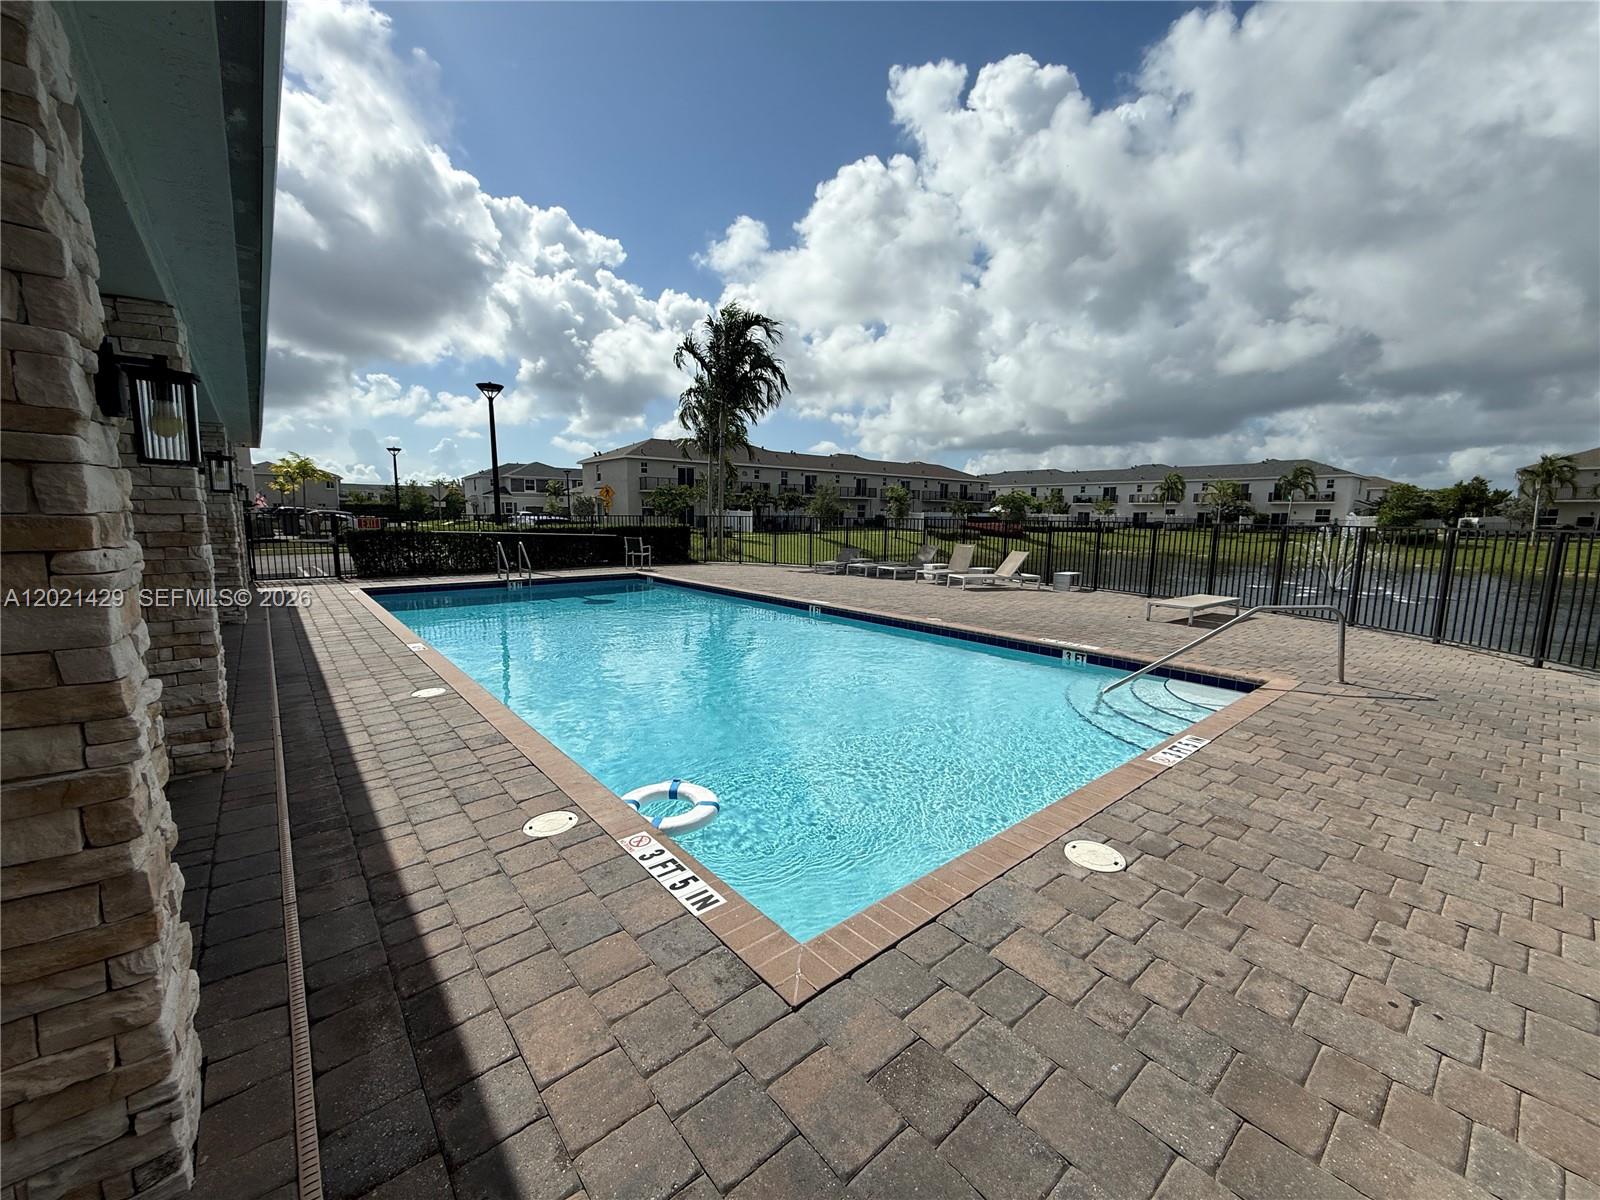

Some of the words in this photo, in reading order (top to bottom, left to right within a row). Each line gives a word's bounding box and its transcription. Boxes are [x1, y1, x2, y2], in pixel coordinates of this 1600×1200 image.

[361, 518, 377, 529] EXIT
[638, 848, 666, 861] 3
[648, 857, 687, 878] FT
[669, 875, 700, 891] 5
[685, 889, 720, 912] IN
